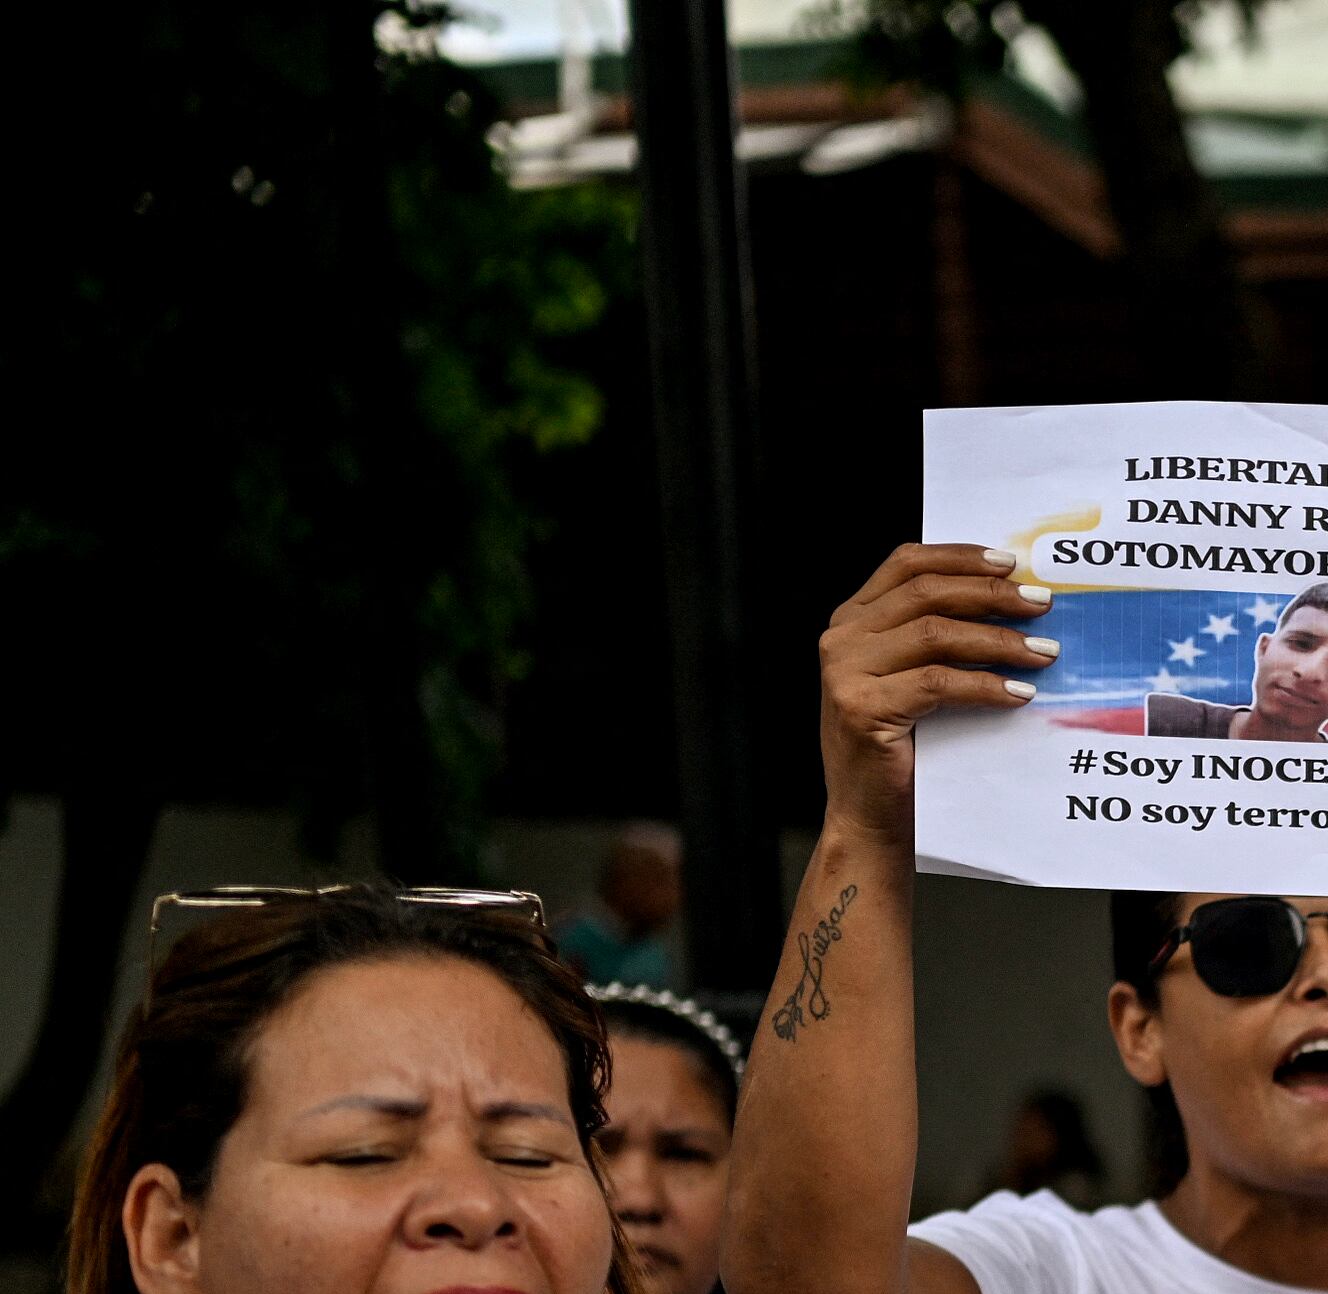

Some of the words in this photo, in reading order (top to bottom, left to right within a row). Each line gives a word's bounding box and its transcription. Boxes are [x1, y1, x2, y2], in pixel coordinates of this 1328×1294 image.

[1127, 499, 1292, 530] DANNY
[1069, 748, 1182, 784] #Soy
[1066, 795, 1132, 822] NO
[1142, 801, 1216, 831] soy
